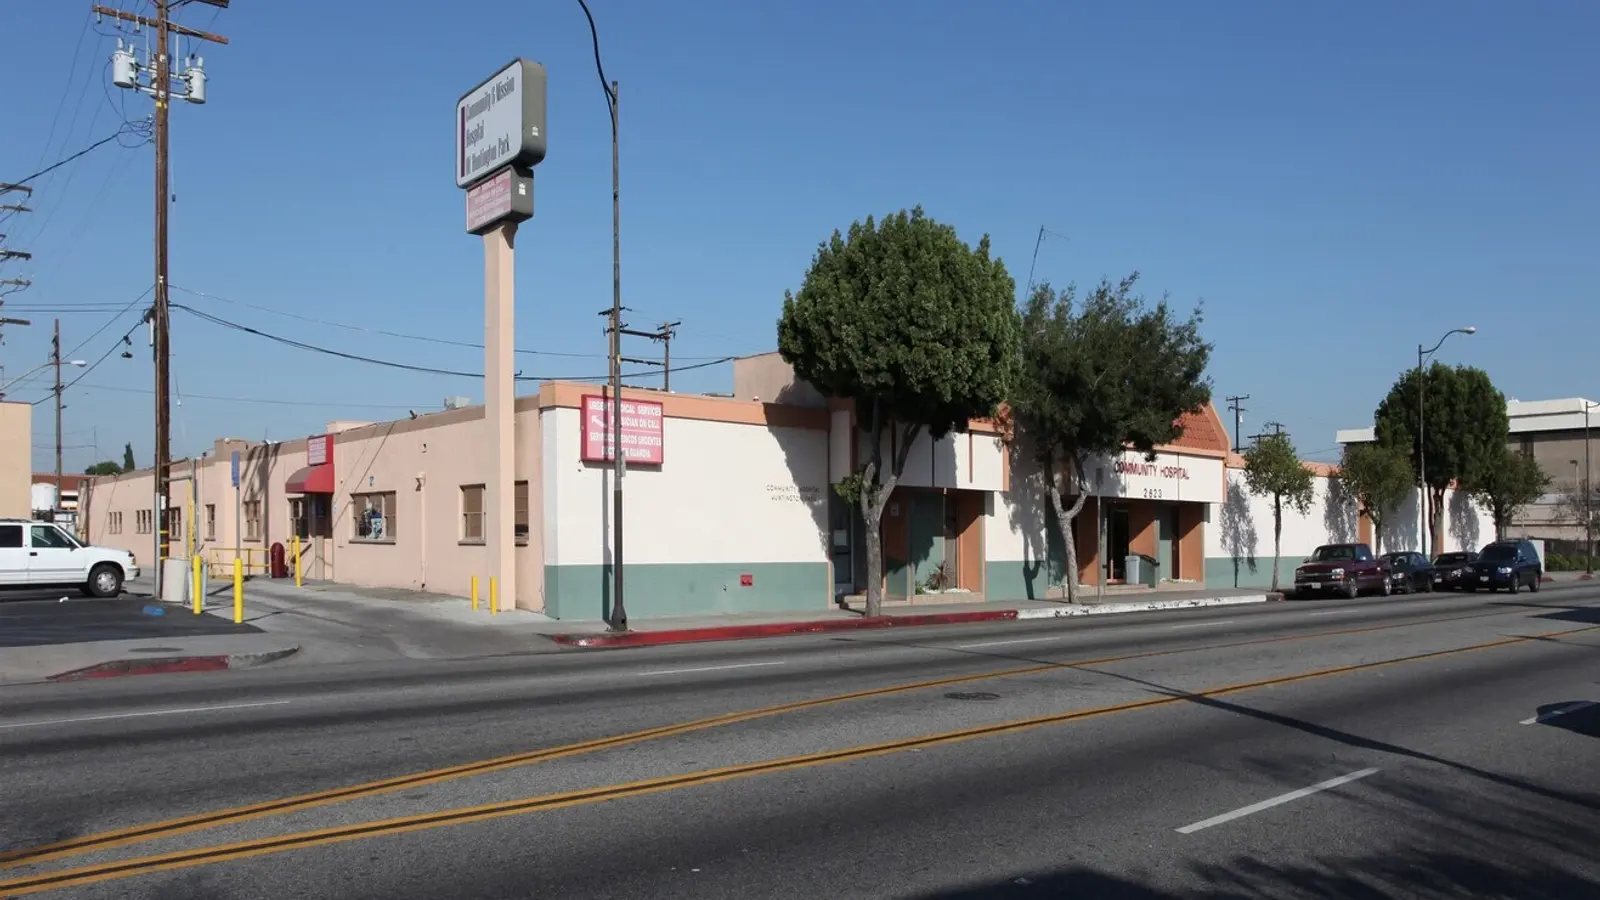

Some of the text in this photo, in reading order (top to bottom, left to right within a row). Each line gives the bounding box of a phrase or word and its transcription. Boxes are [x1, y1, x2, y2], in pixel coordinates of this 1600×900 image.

[466, 92, 490, 122] Community
[496, 76, 515, 101] Mission
[466, 119, 485, 147] Hospital
[472, 144, 497, 172] Huntington
[498, 133, 510, 157] Park
[637, 406, 661, 416] SERVICES
[648, 419, 660, 429] CALL
[1114, 460, 1189, 479] COMMUNITY HOSPITAL
